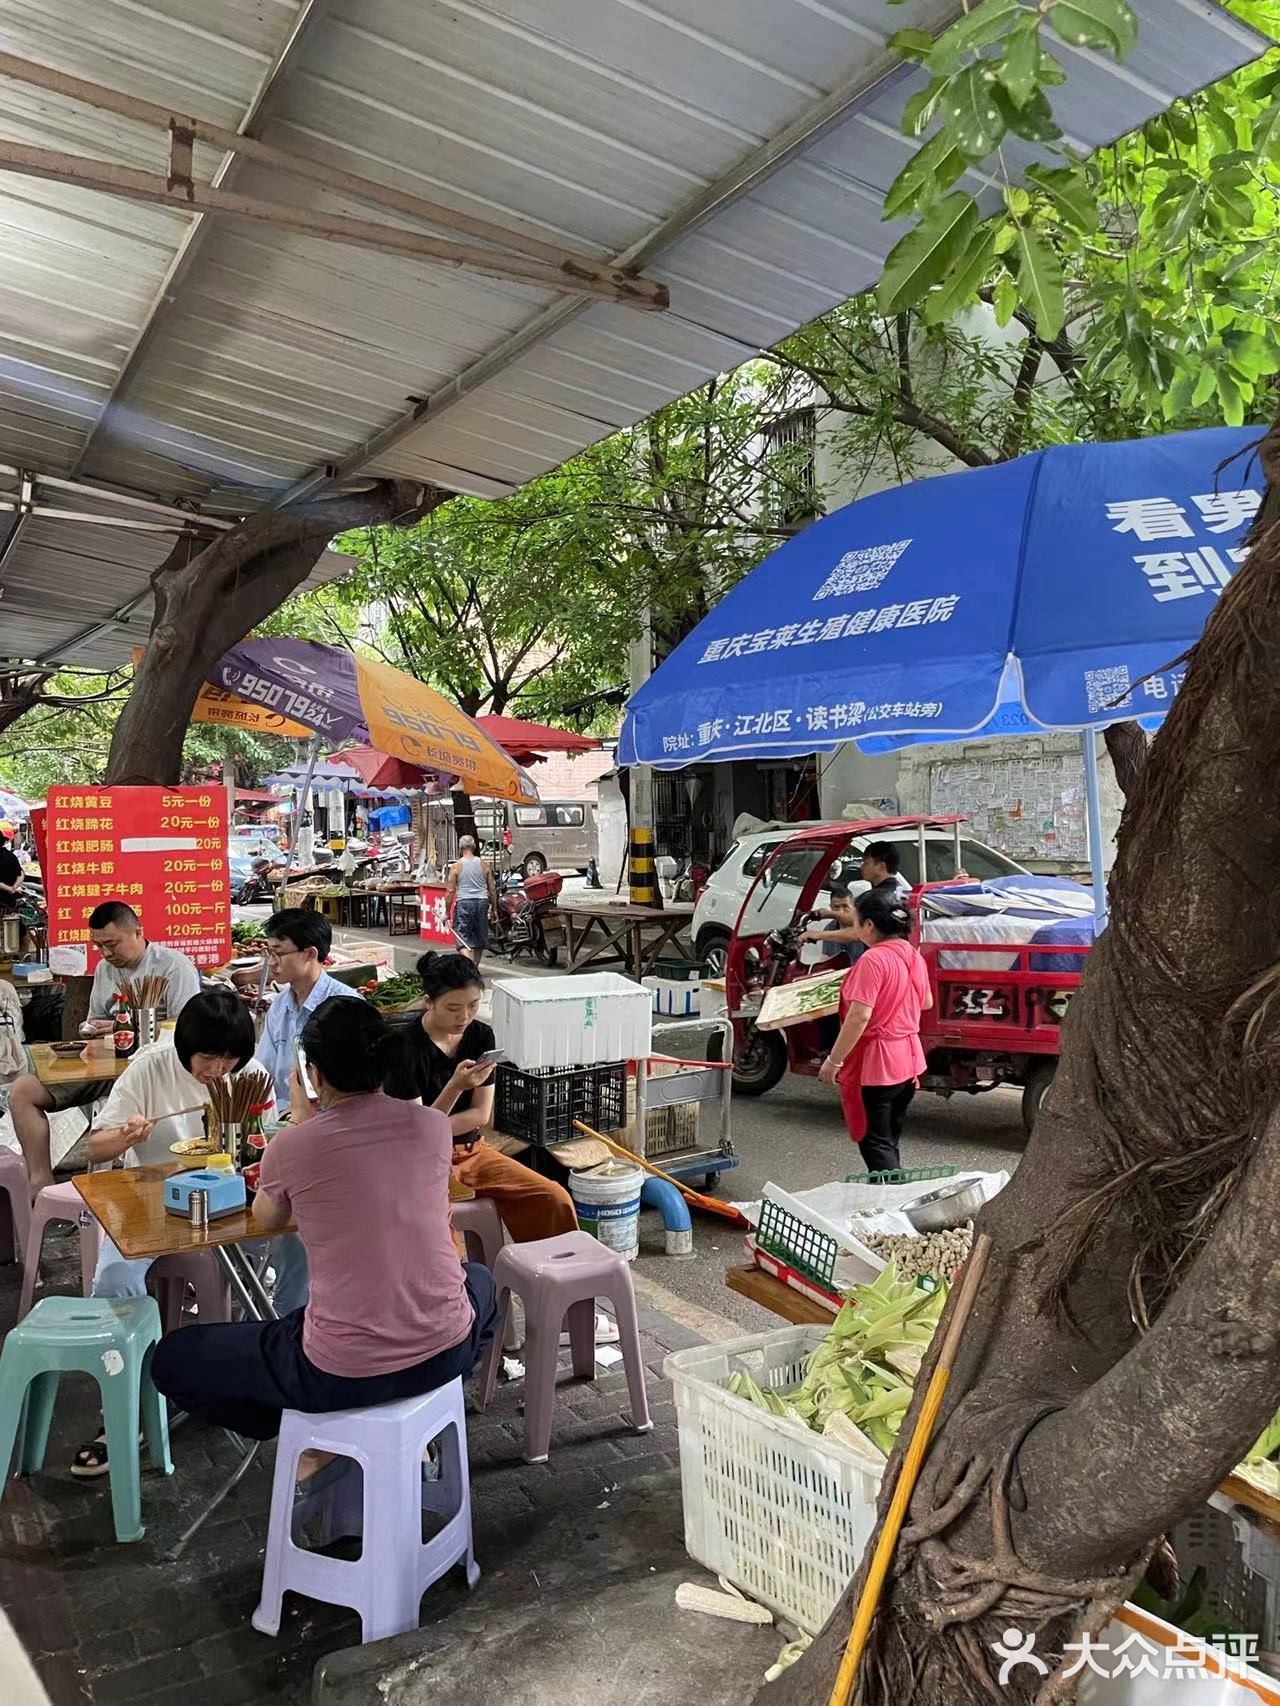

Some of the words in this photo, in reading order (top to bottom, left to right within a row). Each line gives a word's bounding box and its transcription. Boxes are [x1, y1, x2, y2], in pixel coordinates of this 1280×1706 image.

[1133, 546, 1252, 602] 到
[697, 594, 960, 664] 重庆宝莱生殖健康医院
[237, 673, 311, 718] 95079
[55, 796, 113, 808] 红烧黄豆
[162, 795, 211, 808] 5元一份
[55, 818, 114, 830] 红烧蹄花
[160, 816, 220, 829] 20元一份
[56, 840, 114, 852] 红烧肥肠
[196, 838, 221, 849] 20元
[56, 862, 115, 875] 红烧牛筋
[163, 859, 223, 872] 20元一份
[164, 880, 224, 893] 20元一份
[165, 902, 226, 915] 100元一斤
[165, 923, 226, 936] 120元一斤
